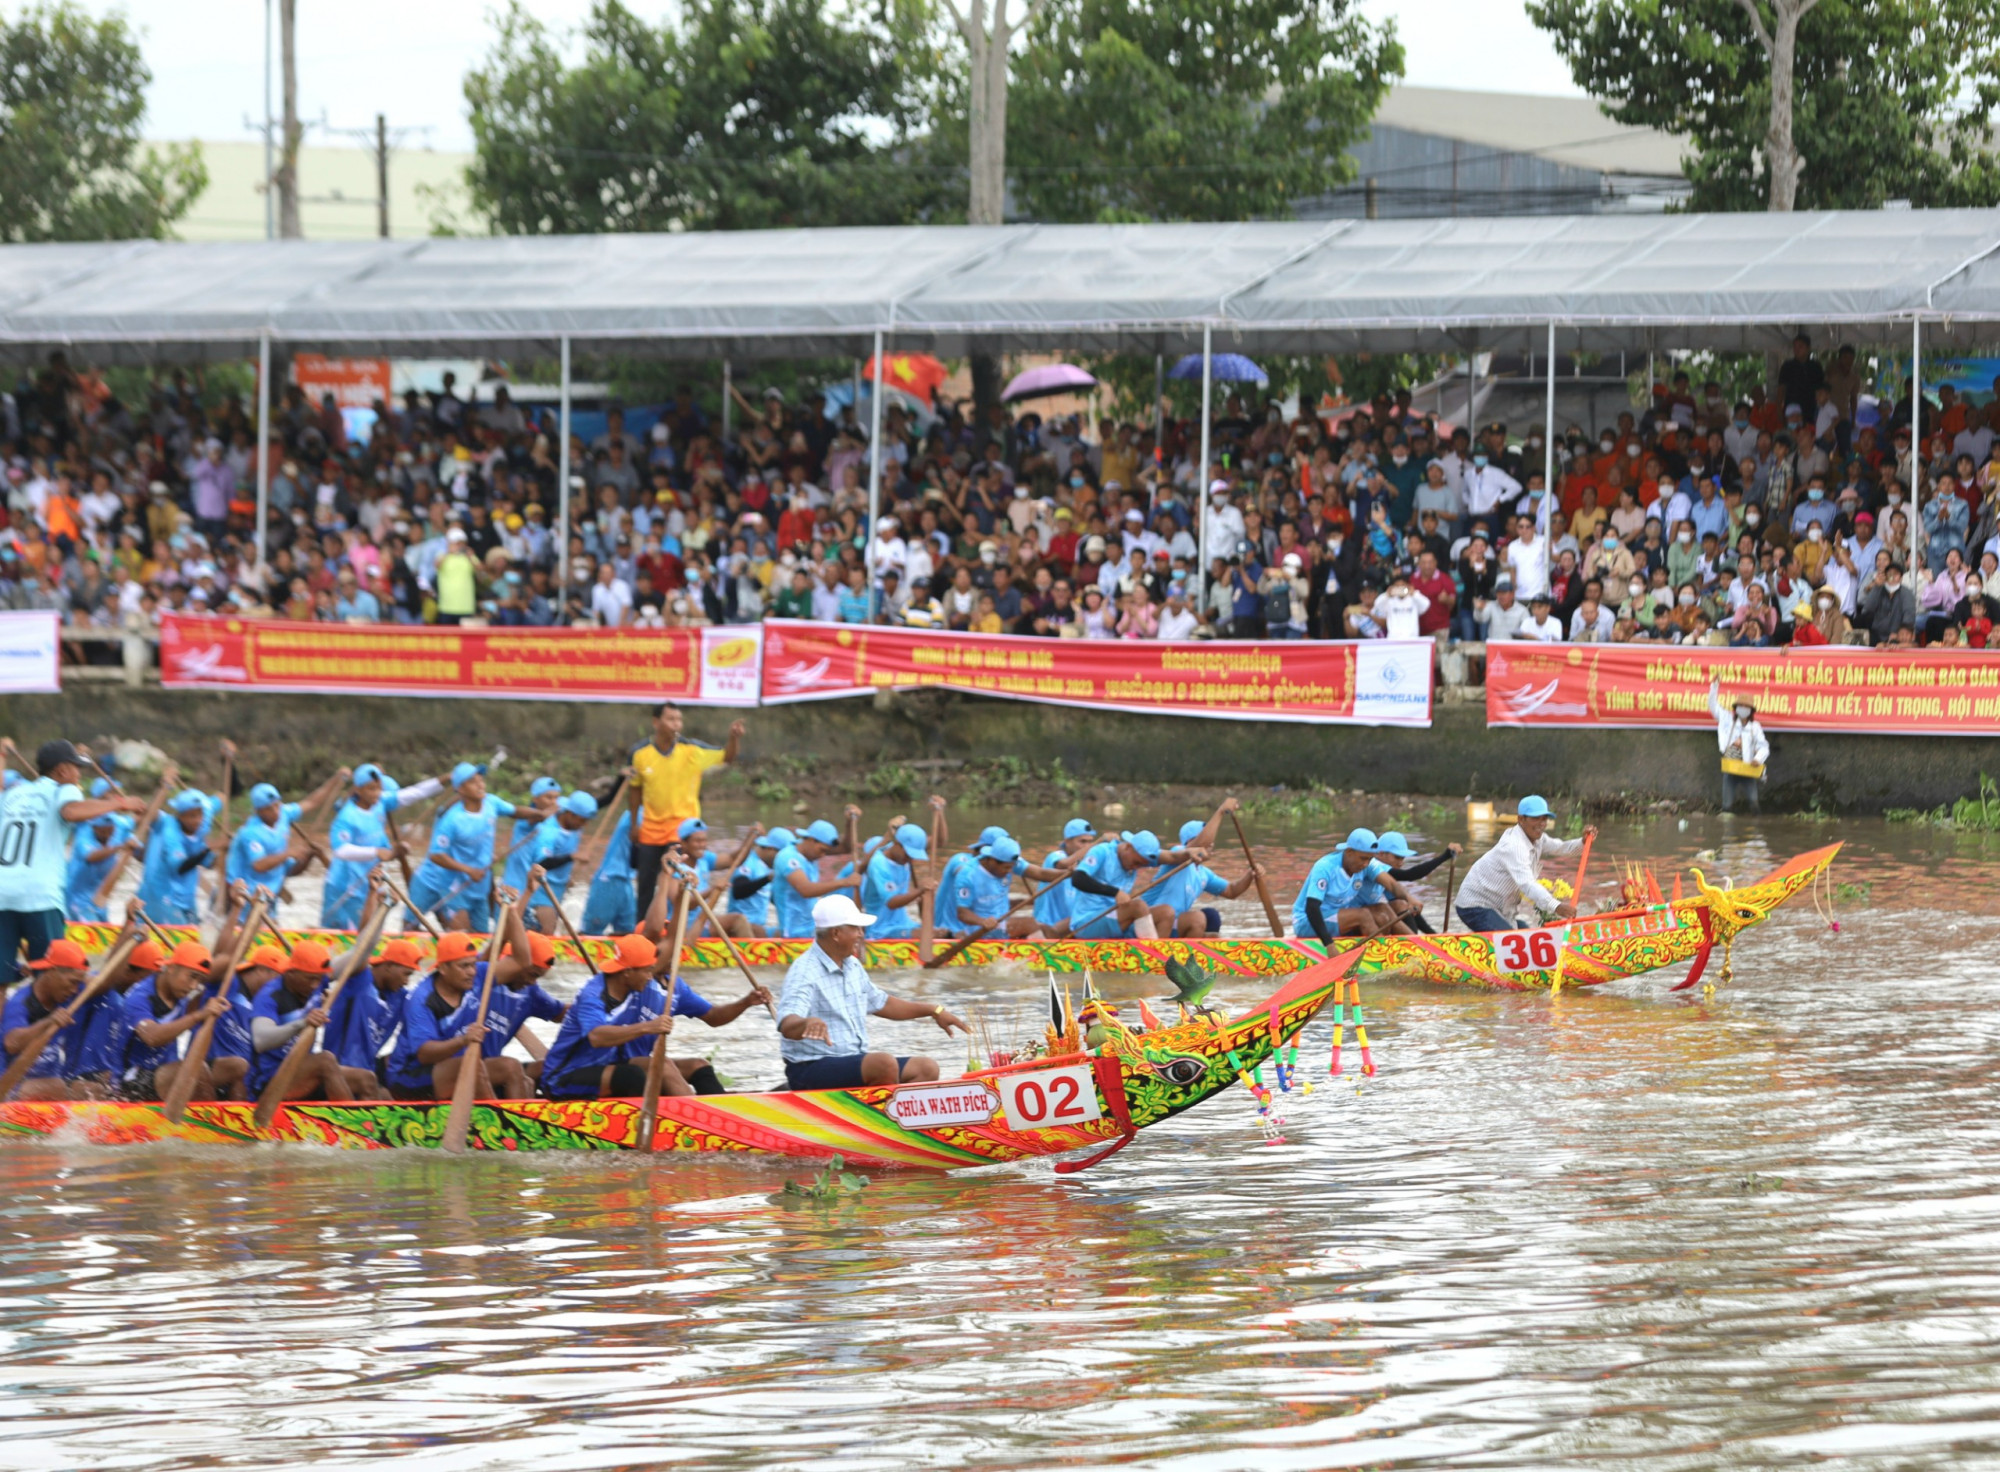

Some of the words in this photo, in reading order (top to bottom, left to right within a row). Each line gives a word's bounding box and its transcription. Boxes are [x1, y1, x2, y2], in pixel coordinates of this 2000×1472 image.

[1646, 657, 1673, 681] BẢO
[1709, 660, 1742, 684] PHÁT
[1746, 664, 1772, 684] HUY
[1806, 660, 1833, 685] SẮC
[1837, 663, 1864, 686] VĂN
[1867, 663, 1895, 686] HÓA
[1637, 689, 1663, 711] SÓC
[1667, 690, 1709, 712] TRĂNG
[1795, 691, 1833, 715] ĐOÀN
[1836, 690, 1863, 717] KẾT,
[1867, 693, 1893, 717] TÔN
[1896, 696, 1944, 721] TRỌNG,
[1948, 694, 1971, 722] HỘI
[1501, 931, 1557, 970] 36
[896, 1095, 928, 1117] CHÙA
[928, 1096, 962, 1115] WATH
[962, 1090, 989, 1112] PÍCH
[1014, 1076, 1085, 1122] 02
